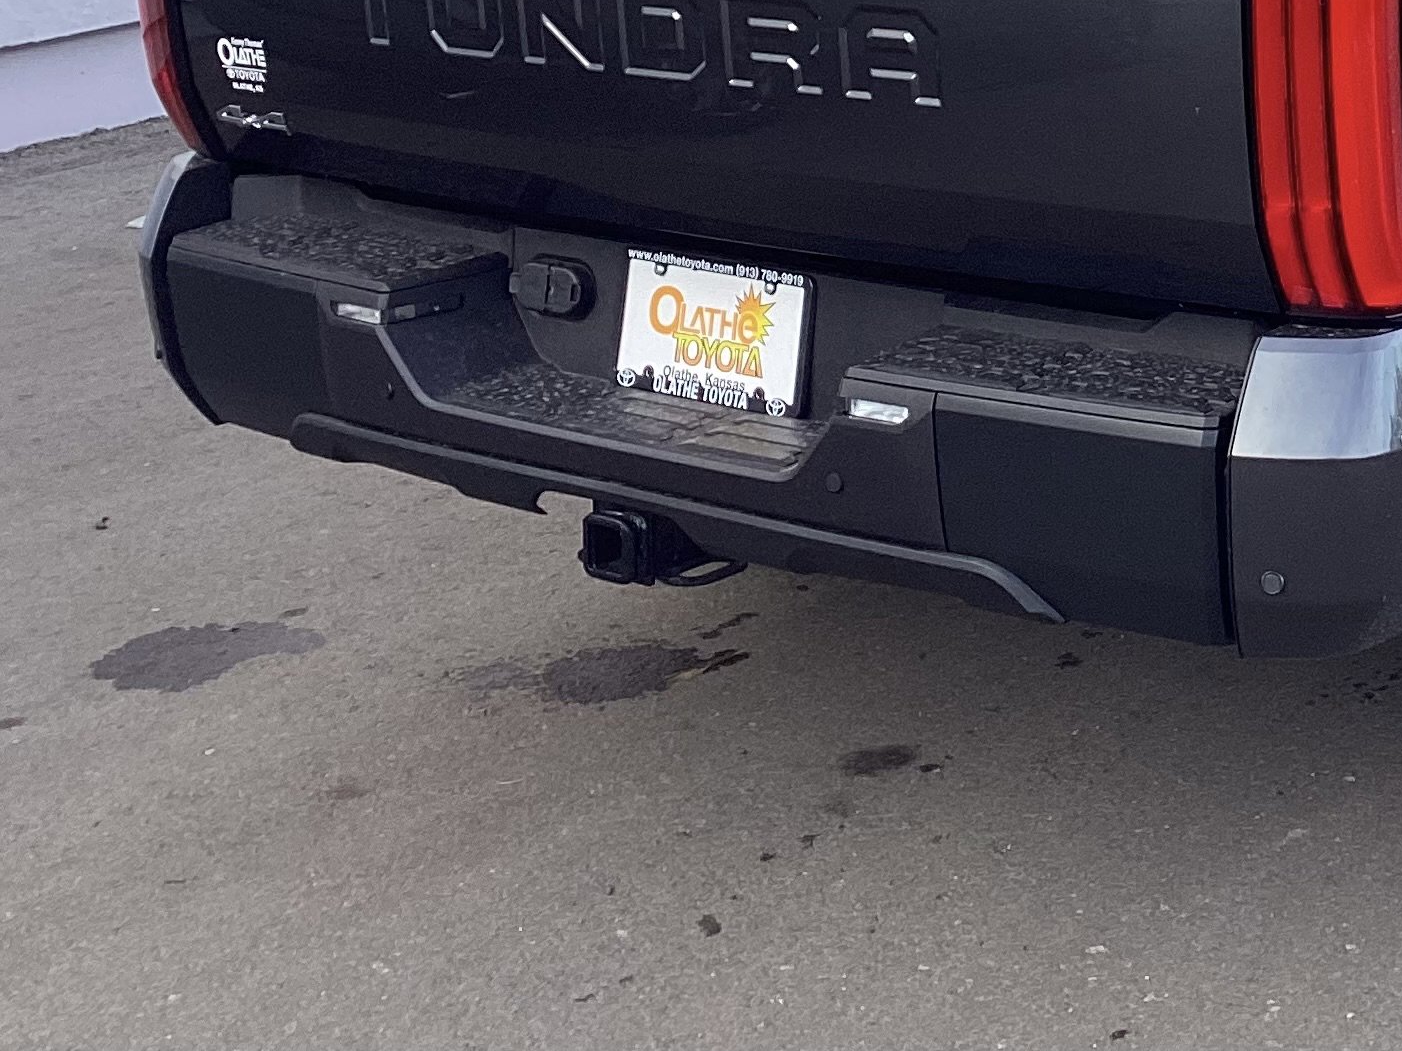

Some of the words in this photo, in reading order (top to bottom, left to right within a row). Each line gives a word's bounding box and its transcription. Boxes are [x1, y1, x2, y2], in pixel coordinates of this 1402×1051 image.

[217, 37, 267, 68] OLATHE
[234, 69, 266, 83] TOYOTA
[628, 249, 734, 276] www.olathetoyota.com
[735, 263, 759, 280] (913)
[761, 268, 804, 287] 780-9919
[673, 332, 763, 379] TOYOTA
[653, 374, 699, 400] OLATHE
[703, 386, 748, 410] TOYOTA
[705, 372, 746, 392] Kansas
